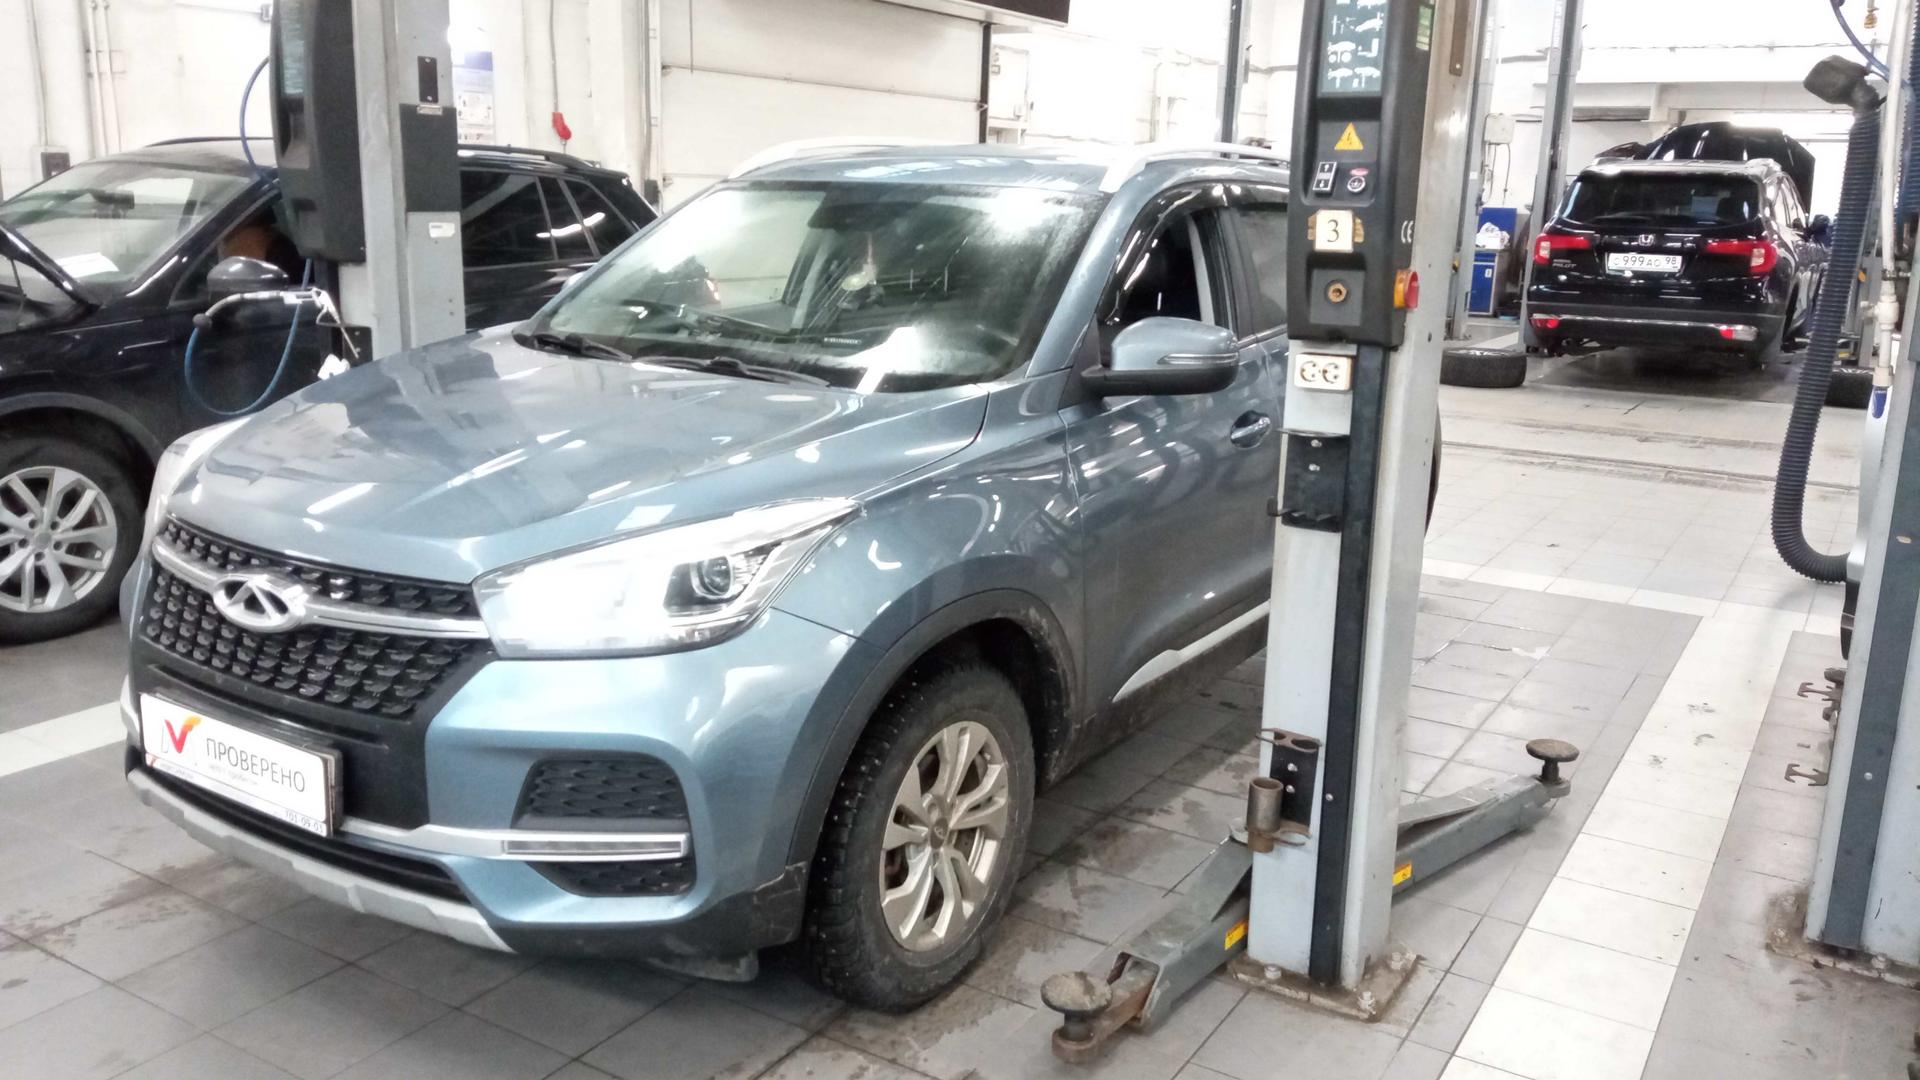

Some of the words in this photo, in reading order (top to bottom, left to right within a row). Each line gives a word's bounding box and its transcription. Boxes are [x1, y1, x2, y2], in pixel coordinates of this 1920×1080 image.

[1327, 219, 1340, 242] 3
[1665, 256, 1677, 265] 98
[206, 738, 305, 792] ПРОВЕРЕНО
